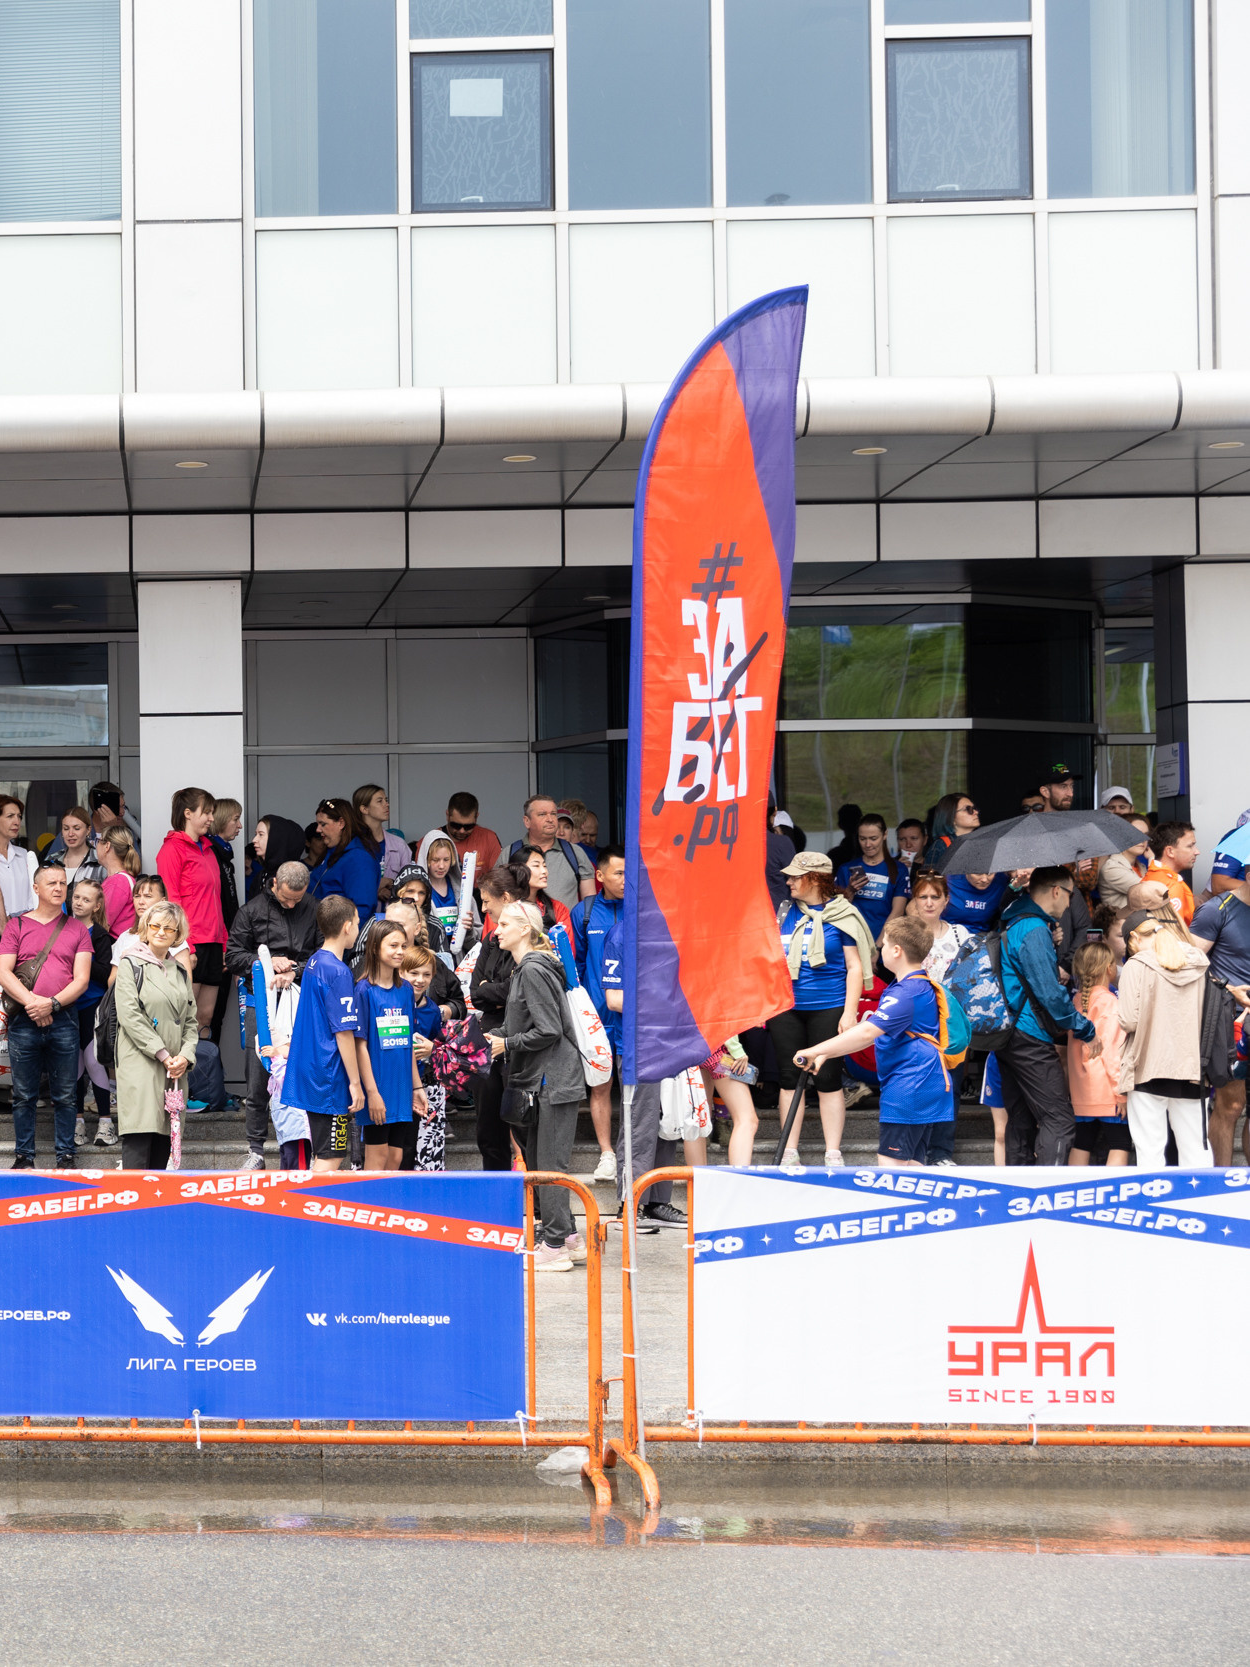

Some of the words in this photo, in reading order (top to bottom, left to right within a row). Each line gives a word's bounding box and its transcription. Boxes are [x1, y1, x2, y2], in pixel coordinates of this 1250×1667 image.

[605, 959, 619, 975] 7
[340, 997, 353, 1012] 7
[382, 1038, 408, 1046] 20195
[180, 1170, 313, 1197] ЗАБЕГ.РФ
[8, 1190, 139, 1219] ЗАБЕГ.РФ
[1008, 1179, 1173, 1215] ЗАБЕГ.РФ
[303, 1201, 429, 1231] ЗАБЕГ.РФ
[794, 1207, 957, 1244] ЗАБЕГ.РФ
[335, 1312, 450, 1327] vk.com/heroleague
[126, 1358, 177, 1371] ЛИГА
[184, 1358, 257, 1371] ГЕРОЕВ
[948, 1341, 1115, 1377] УРАЛ
[948, 1389, 1033, 1403] SINCE
[1047, 1390, 1115, 1403] 1900
